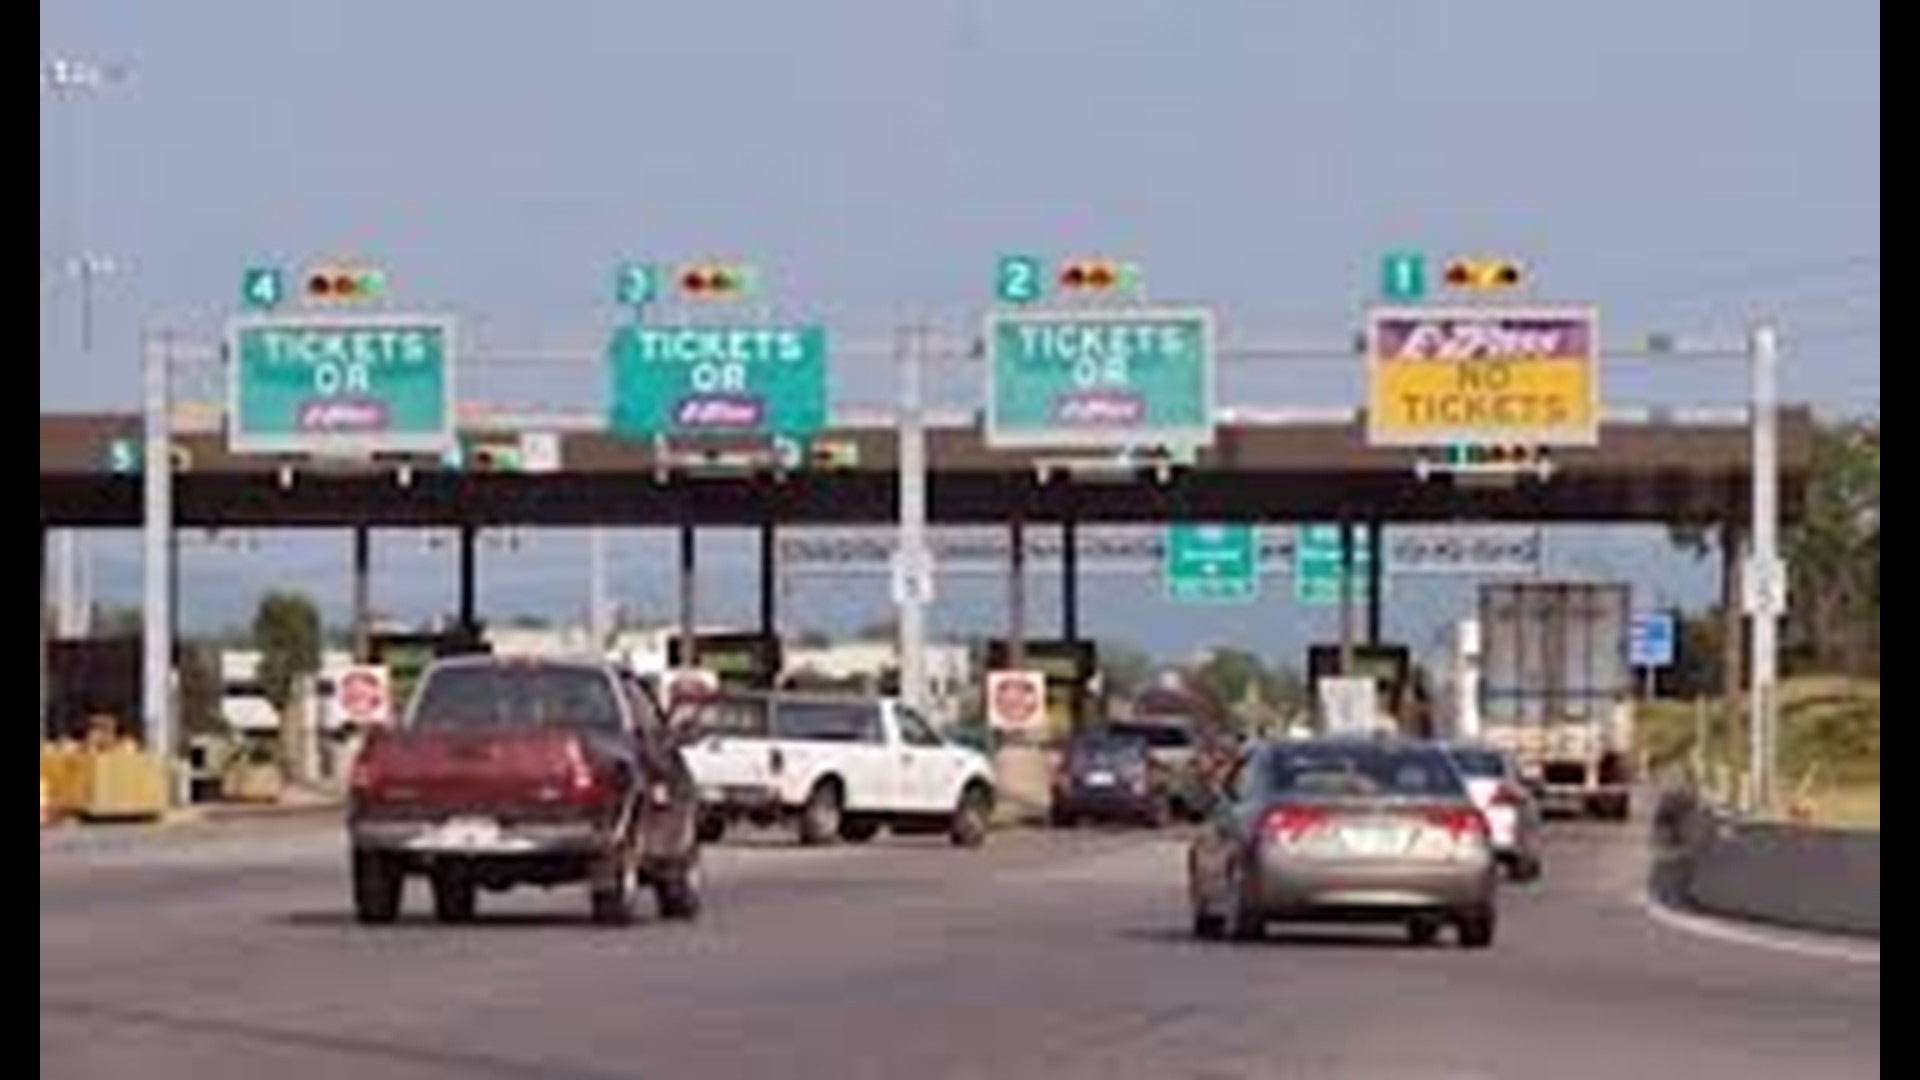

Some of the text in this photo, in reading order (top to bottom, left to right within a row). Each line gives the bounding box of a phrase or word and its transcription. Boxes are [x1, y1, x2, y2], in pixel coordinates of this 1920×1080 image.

[251, 273, 276, 302] 4
[1004, 260, 1032, 298] 2
[1396, 260, 1411, 293] 1
[263, 330, 427, 363] TICKETS
[640, 330, 805, 361] TICKETS
[1019, 325, 1184, 358] TICKETS
[314, 362, 370, 396] OR
[691, 362, 747, 393] OR
[1073, 355, 1129, 387] OR
[1456, 361, 1512, 391] NO
[1401, 393, 1568, 425] TICKETS
